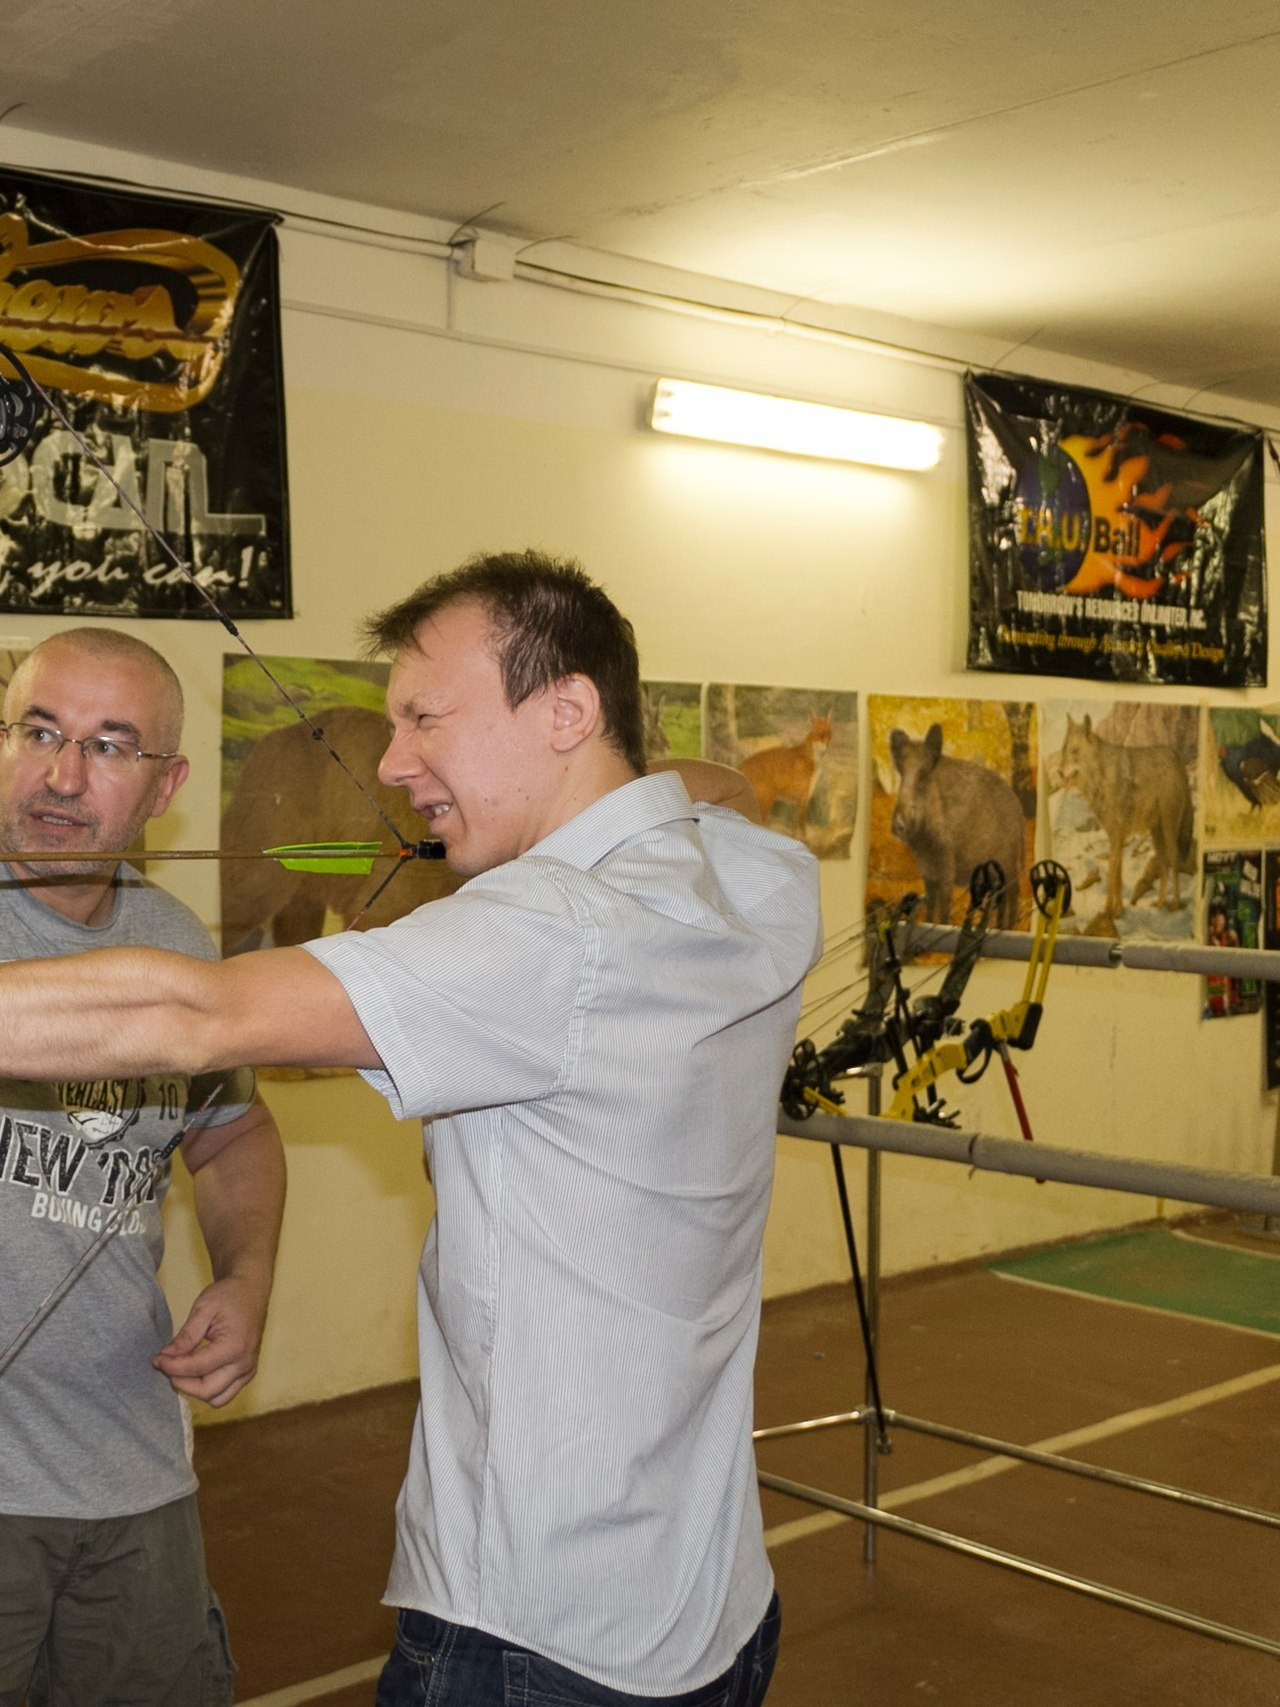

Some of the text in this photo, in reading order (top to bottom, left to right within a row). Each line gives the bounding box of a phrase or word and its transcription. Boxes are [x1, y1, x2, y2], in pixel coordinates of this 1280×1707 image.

[1093, 515, 1140, 558] Ball
[27, 558, 130, 598] you
[142, 546, 255, 588] can!
